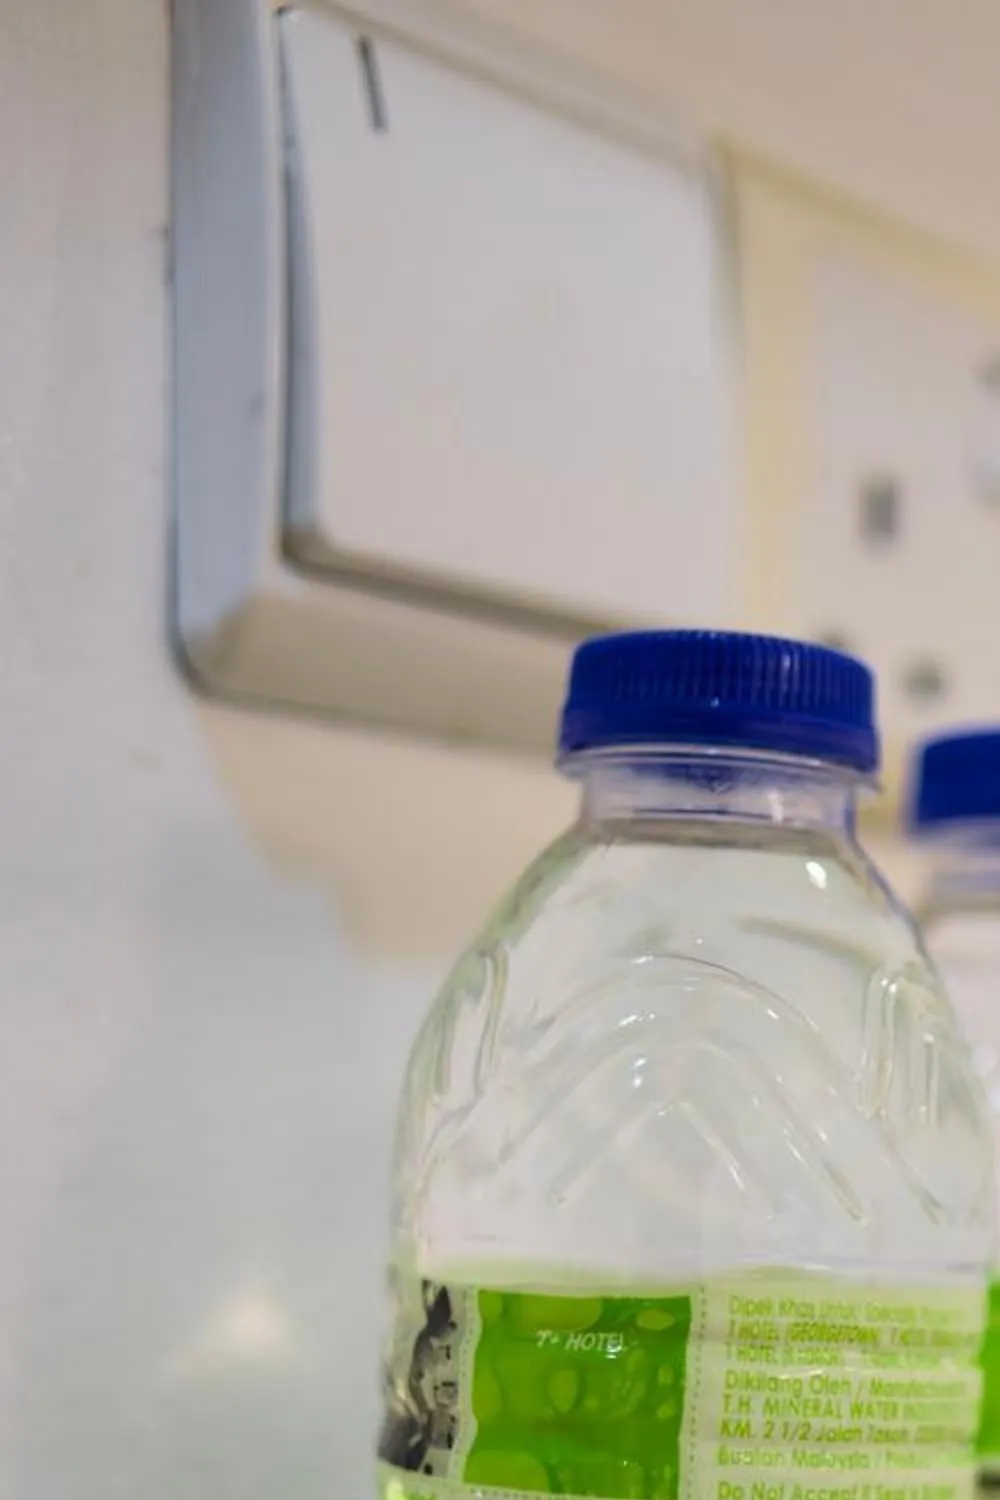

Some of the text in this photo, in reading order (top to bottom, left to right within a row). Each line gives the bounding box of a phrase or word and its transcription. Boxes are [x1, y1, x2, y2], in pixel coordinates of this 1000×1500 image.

[738, 1319, 779, 1341] HOTEL
[564, 1331, 628, 1353] HOTEL
[736, 1343, 779, 1363] HOTEL
[762, 1396, 843, 1419] MINERAL
[849, 1400, 898, 1420] WATER
[718, 1481, 744, 1500] Do
